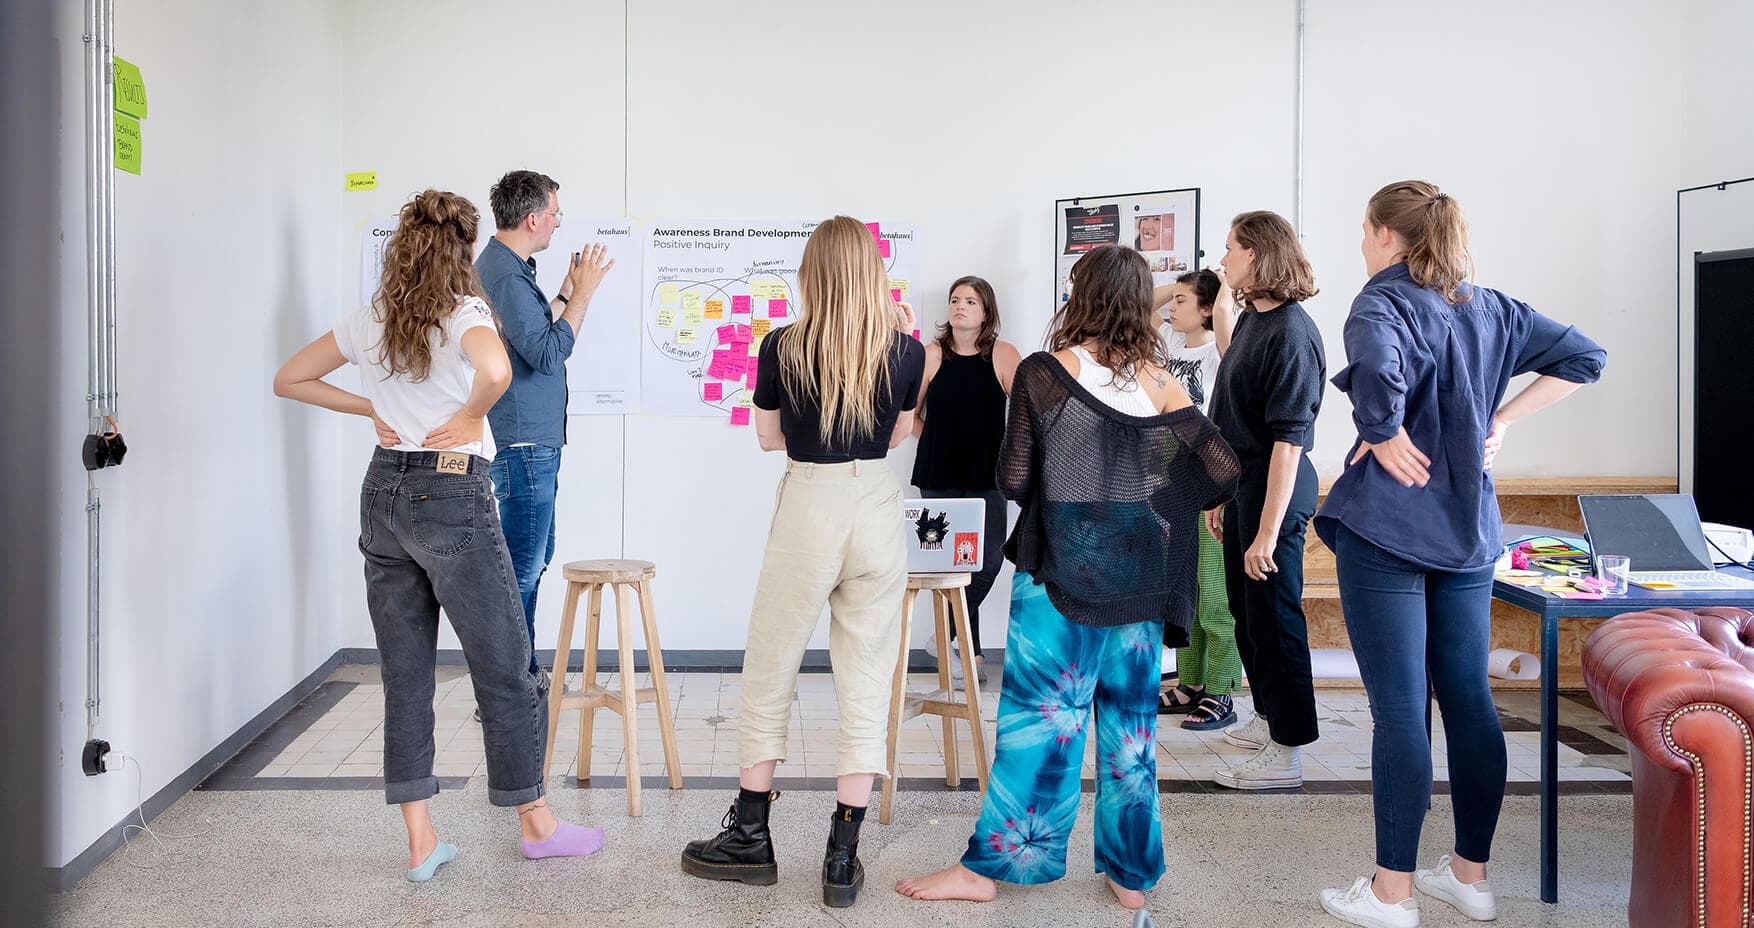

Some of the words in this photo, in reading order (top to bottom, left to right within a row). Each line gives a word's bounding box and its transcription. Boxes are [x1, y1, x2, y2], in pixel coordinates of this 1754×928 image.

[653, 228, 711, 237] Awareness
[713, 228, 745, 237] Brand
[748, 228, 813, 239] Developmen
[653, 240, 693, 249] Positive
[694, 240, 731, 251] Inquiry
[441, 456, 465, 471] Lee
[904, 509, 921, 519] WORK
